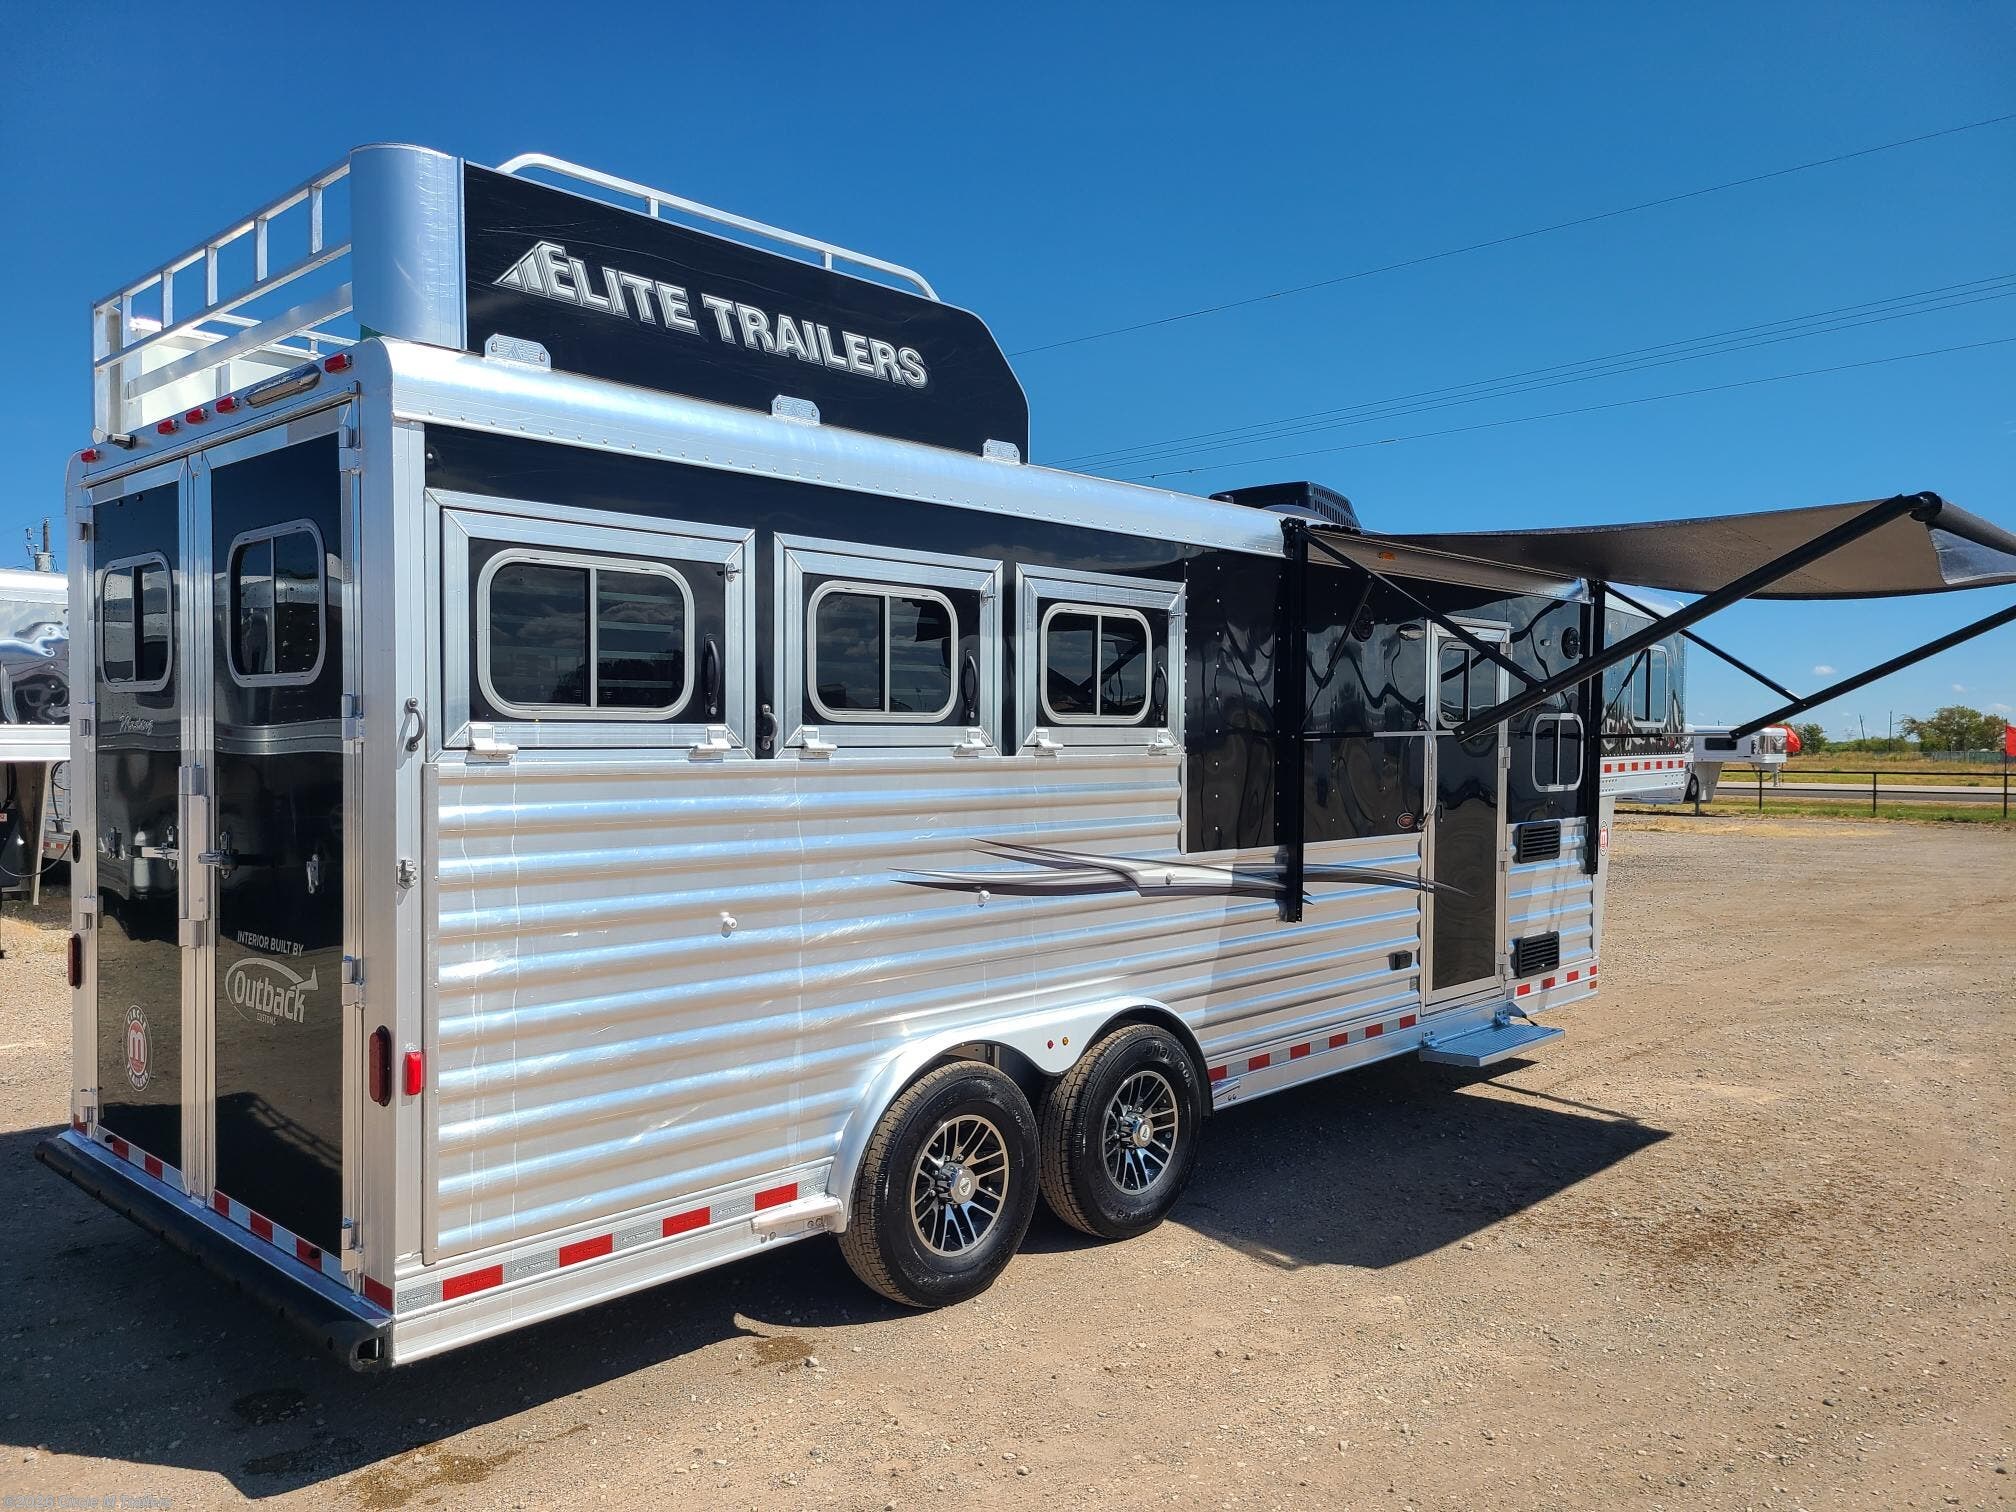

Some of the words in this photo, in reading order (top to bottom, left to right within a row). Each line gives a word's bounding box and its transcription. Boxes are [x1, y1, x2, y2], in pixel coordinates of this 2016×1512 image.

[492, 241, 699, 335] ELITE
[701, 293, 928, 388] TRAILERS
[237, 930, 269, 950] INTERIOR
[270, 938, 292, 954] BUILT
[292, 942, 304, 957] BY
[234, 970, 306, 1024] Outback
